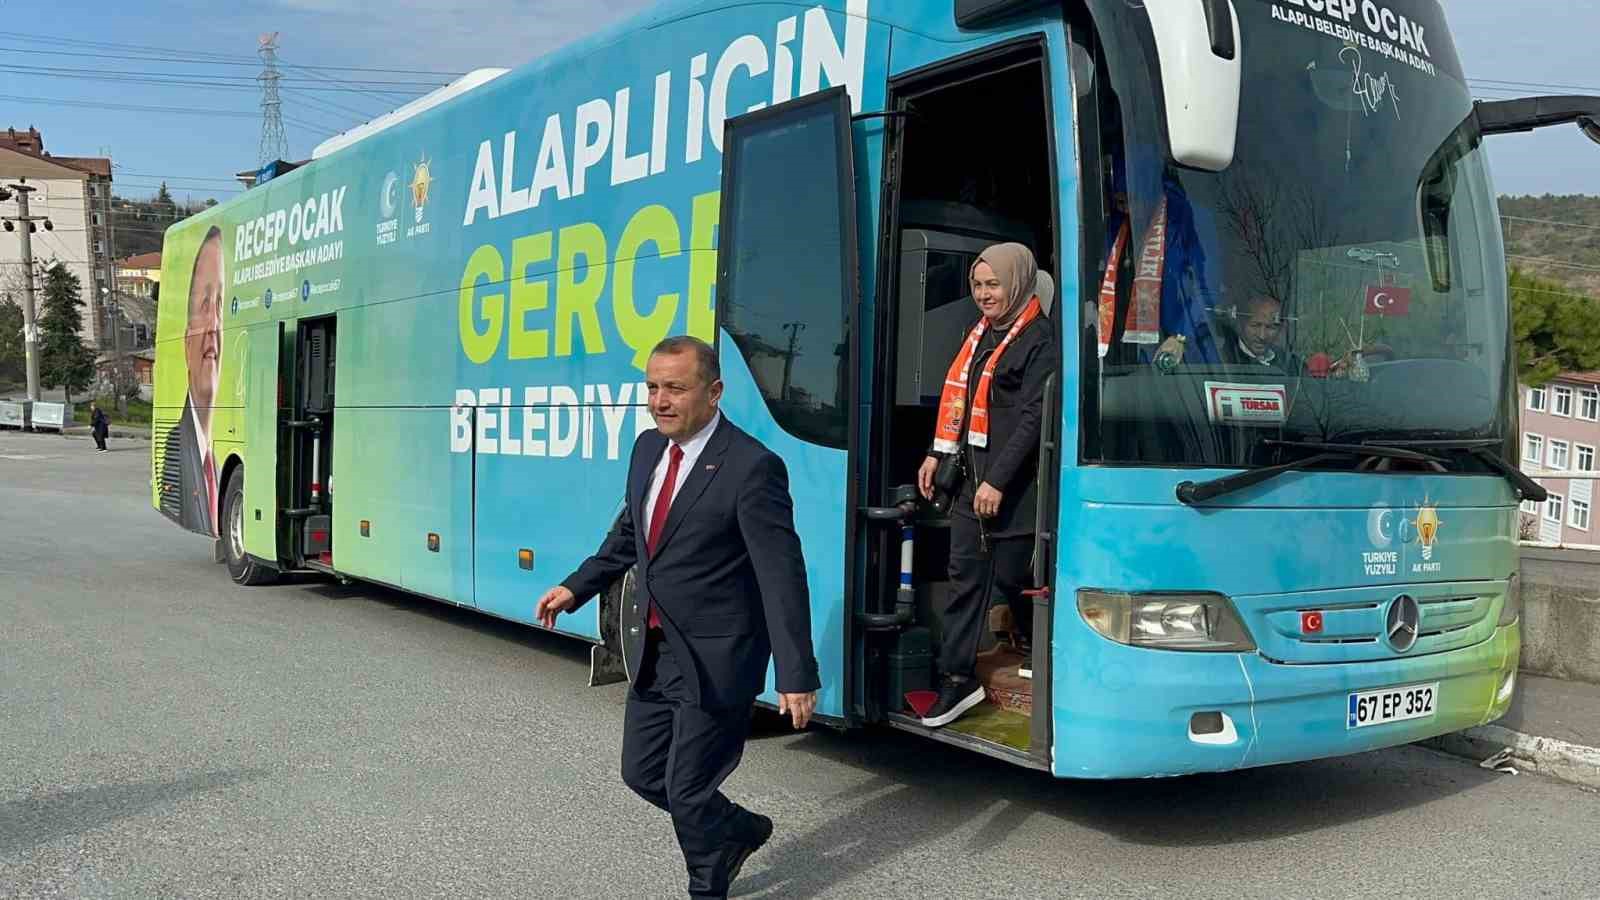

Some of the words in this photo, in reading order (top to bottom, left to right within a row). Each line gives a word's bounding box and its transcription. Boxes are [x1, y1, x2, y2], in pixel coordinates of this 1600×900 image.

[1271, 4, 1315, 30] ALAPLI
[1314, 17, 1368, 48] BELEDİYE
[1367, 35, 1408, 64] BAŞKAN
[1408, 53, 1436, 77] ADAYI
[1361, 0, 1431, 58] OCAK
[463, 71, 671, 226] ALAPLI
[234, 209, 287, 262] RECEP
[288, 186, 346, 245] OCAK
[316, 240, 343, 264] ADAYI
[458, 190, 721, 374] GERÇE
[450, 382, 656, 460] BELEDİY
[1358, 696, 1378, 722] 67
[1383, 693, 1402, 718] EP
[1406, 688, 1432, 714] 352
